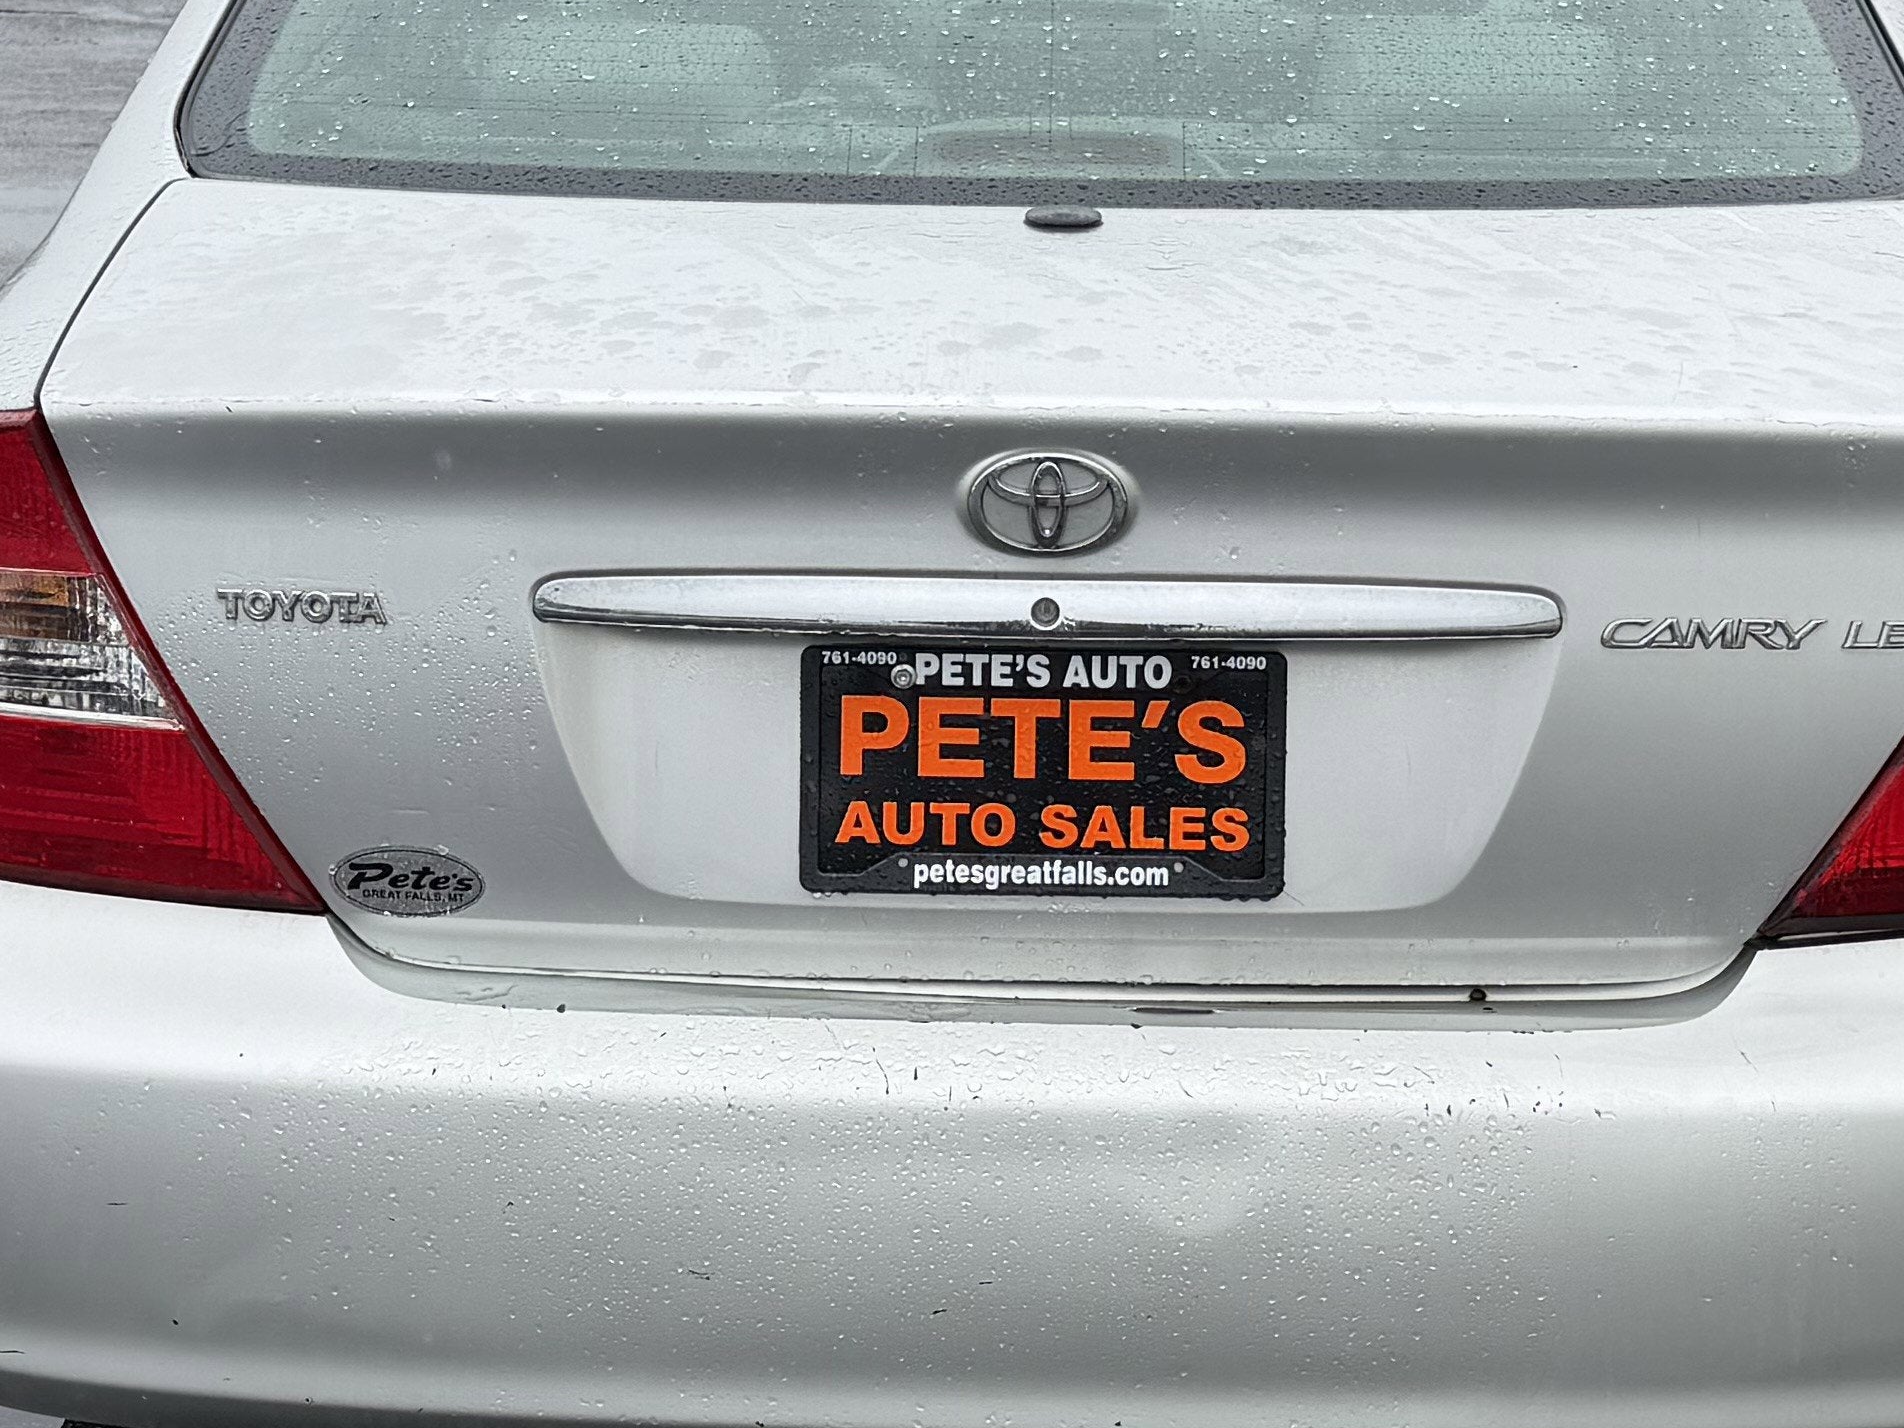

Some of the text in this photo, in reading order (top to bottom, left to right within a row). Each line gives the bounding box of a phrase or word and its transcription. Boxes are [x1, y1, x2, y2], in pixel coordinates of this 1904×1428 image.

[217, 588, 387, 625] TOYOTA
[1601, 617, 1827, 650] CAMRY
[821, 650, 897, 665] 761-4090
[914, 652, 1172, 689] PETE'S AUTO
[1191, 655, 1267, 670] 761-4090
[839, 695, 1246, 784] PETE'S
[834, 801, 1250, 852] AUTO SALES
[348, 862, 474, 891] Pete's
[913, 858, 1169, 891] petesgreatfalls.com
[362, 889, 401, 900] GREAT
[448, 892, 464, 903] MT
